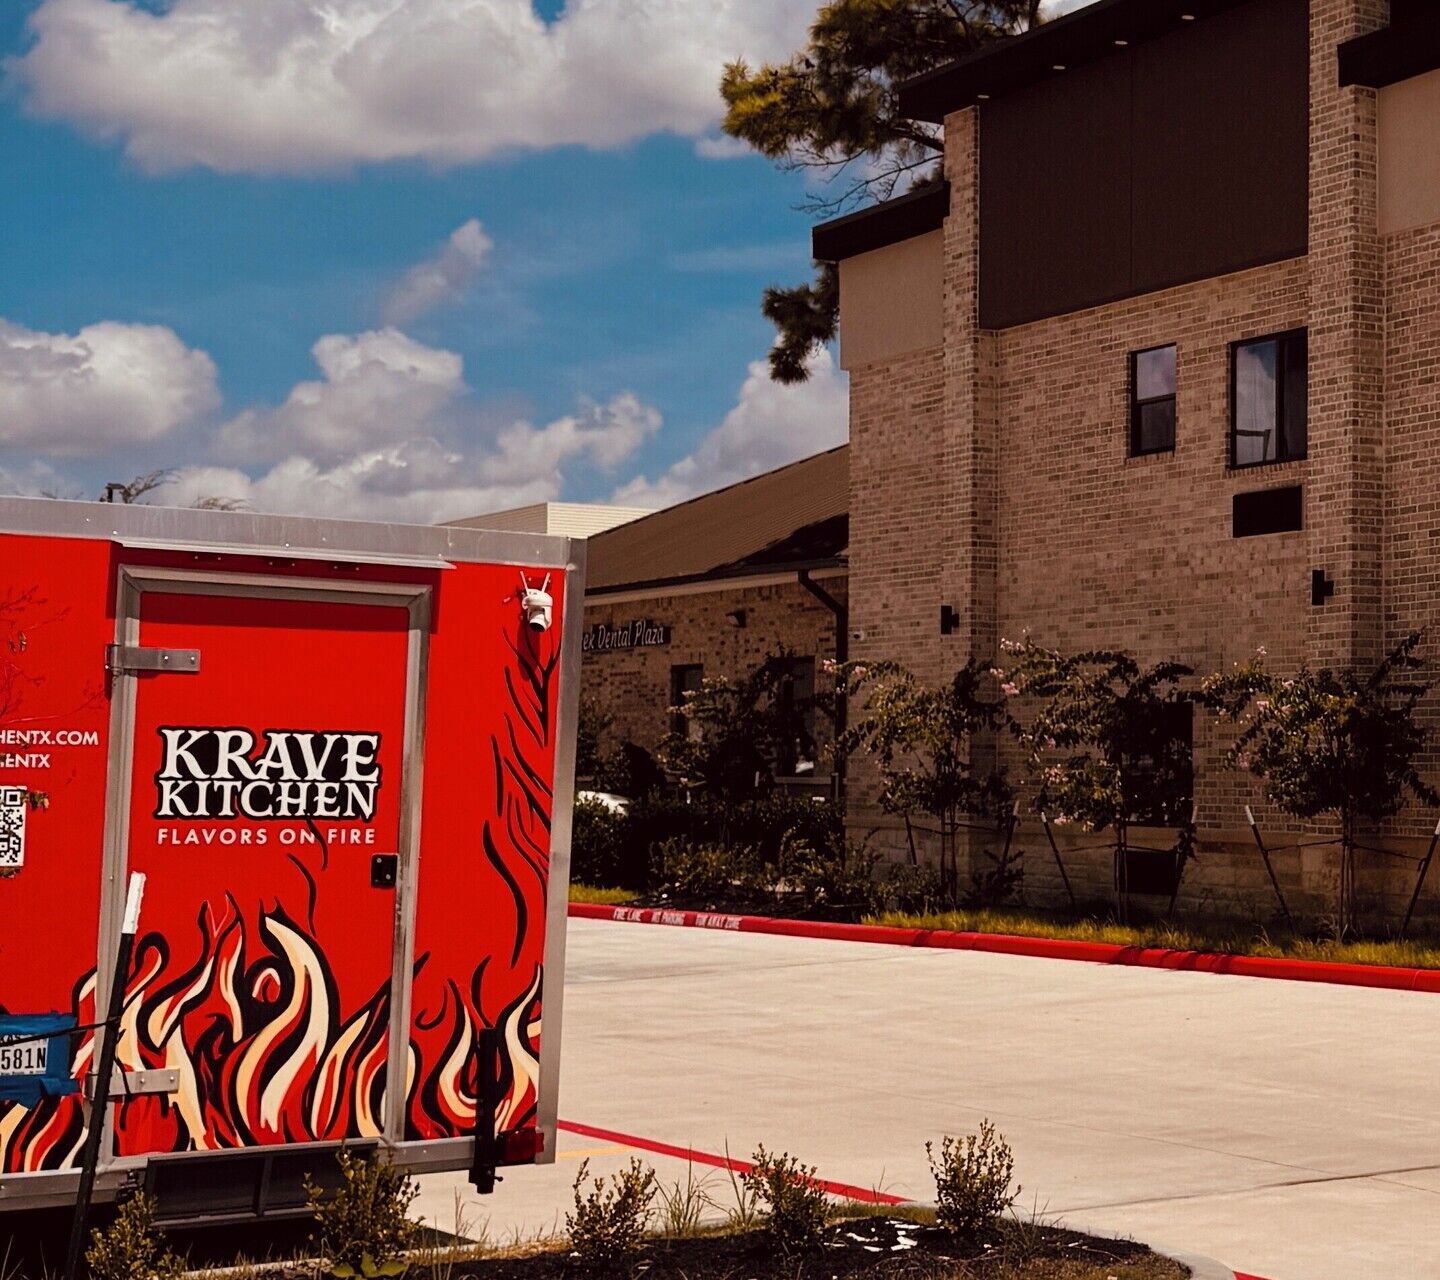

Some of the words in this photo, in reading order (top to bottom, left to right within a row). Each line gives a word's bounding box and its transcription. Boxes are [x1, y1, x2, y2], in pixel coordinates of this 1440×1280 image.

[598, 624, 631, 649] Dental
[634, 619, 664, 645] Plaza
[0, 753, 50, 768] ENTX
[159, 729, 379, 782] KRAVE
[157, 780, 378, 819] KITCHEN
[158, 828, 267, 844] FLAVORS
[280, 828, 315, 844] ON
[328, 828, 375, 844] FIRE
